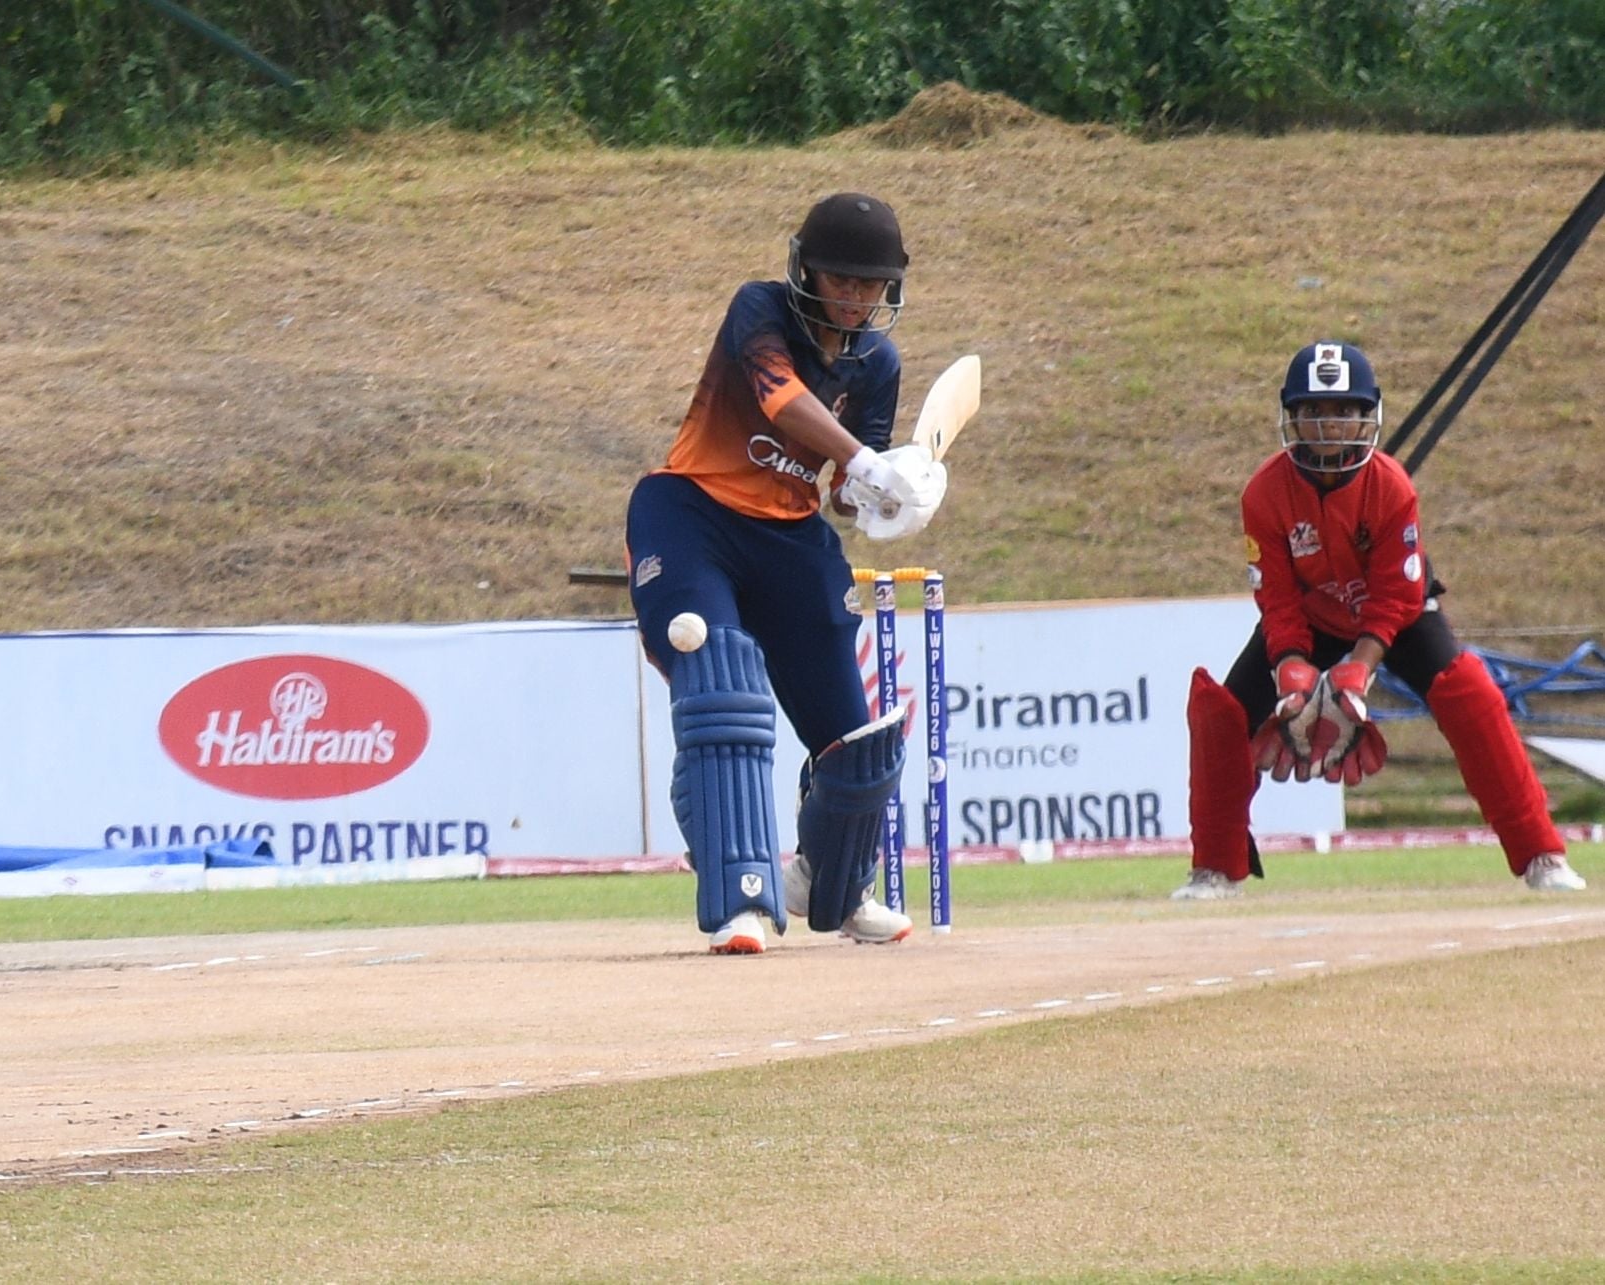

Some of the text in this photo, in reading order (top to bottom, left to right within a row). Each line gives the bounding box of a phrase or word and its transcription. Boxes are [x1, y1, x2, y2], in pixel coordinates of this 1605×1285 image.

[881, 615, 895, 715] LWPL20
[946, 675, 1149, 731] Piramal
[196, 710, 397, 767] Haldiram's
[947, 740, 1081, 770] Finance
[292, 820, 489, 866] PARTNER
[961, 791, 1163, 846] SPONSOR
[886, 797, 902, 912] WPL202
